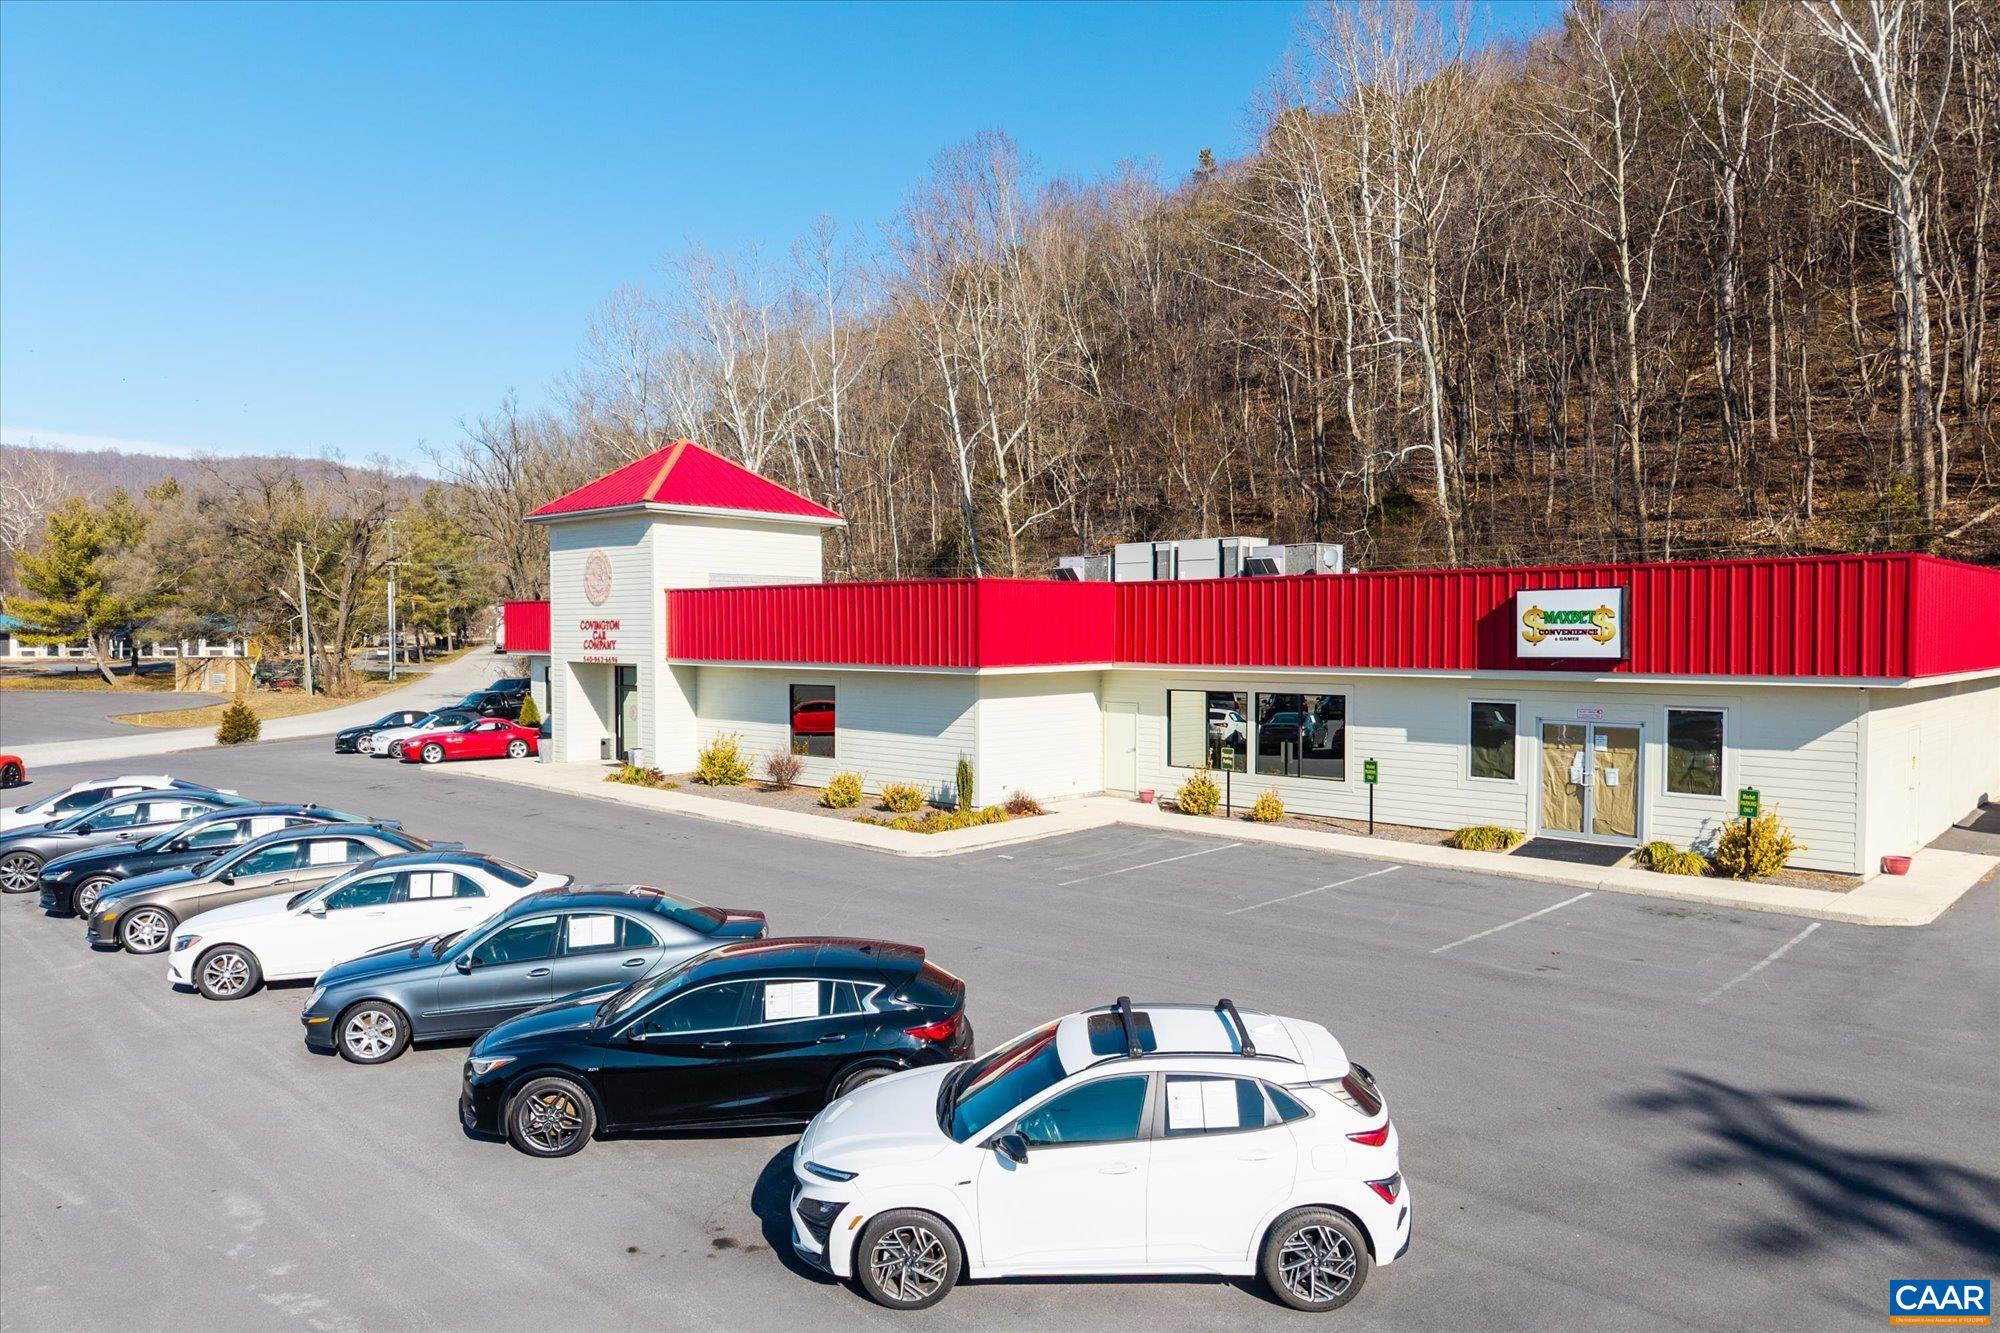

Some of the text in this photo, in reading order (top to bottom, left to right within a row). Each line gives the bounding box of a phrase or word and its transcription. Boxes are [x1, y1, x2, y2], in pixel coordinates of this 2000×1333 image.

[1542, 610, 1596, 624] MAXBET
[580, 620, 620, 631] COVINGTON
[593, 631, 607, 640] CAR
[1538, 628, 1598, 636] CONVENIENCE
[583, 640, 617, 650] COMPANY
